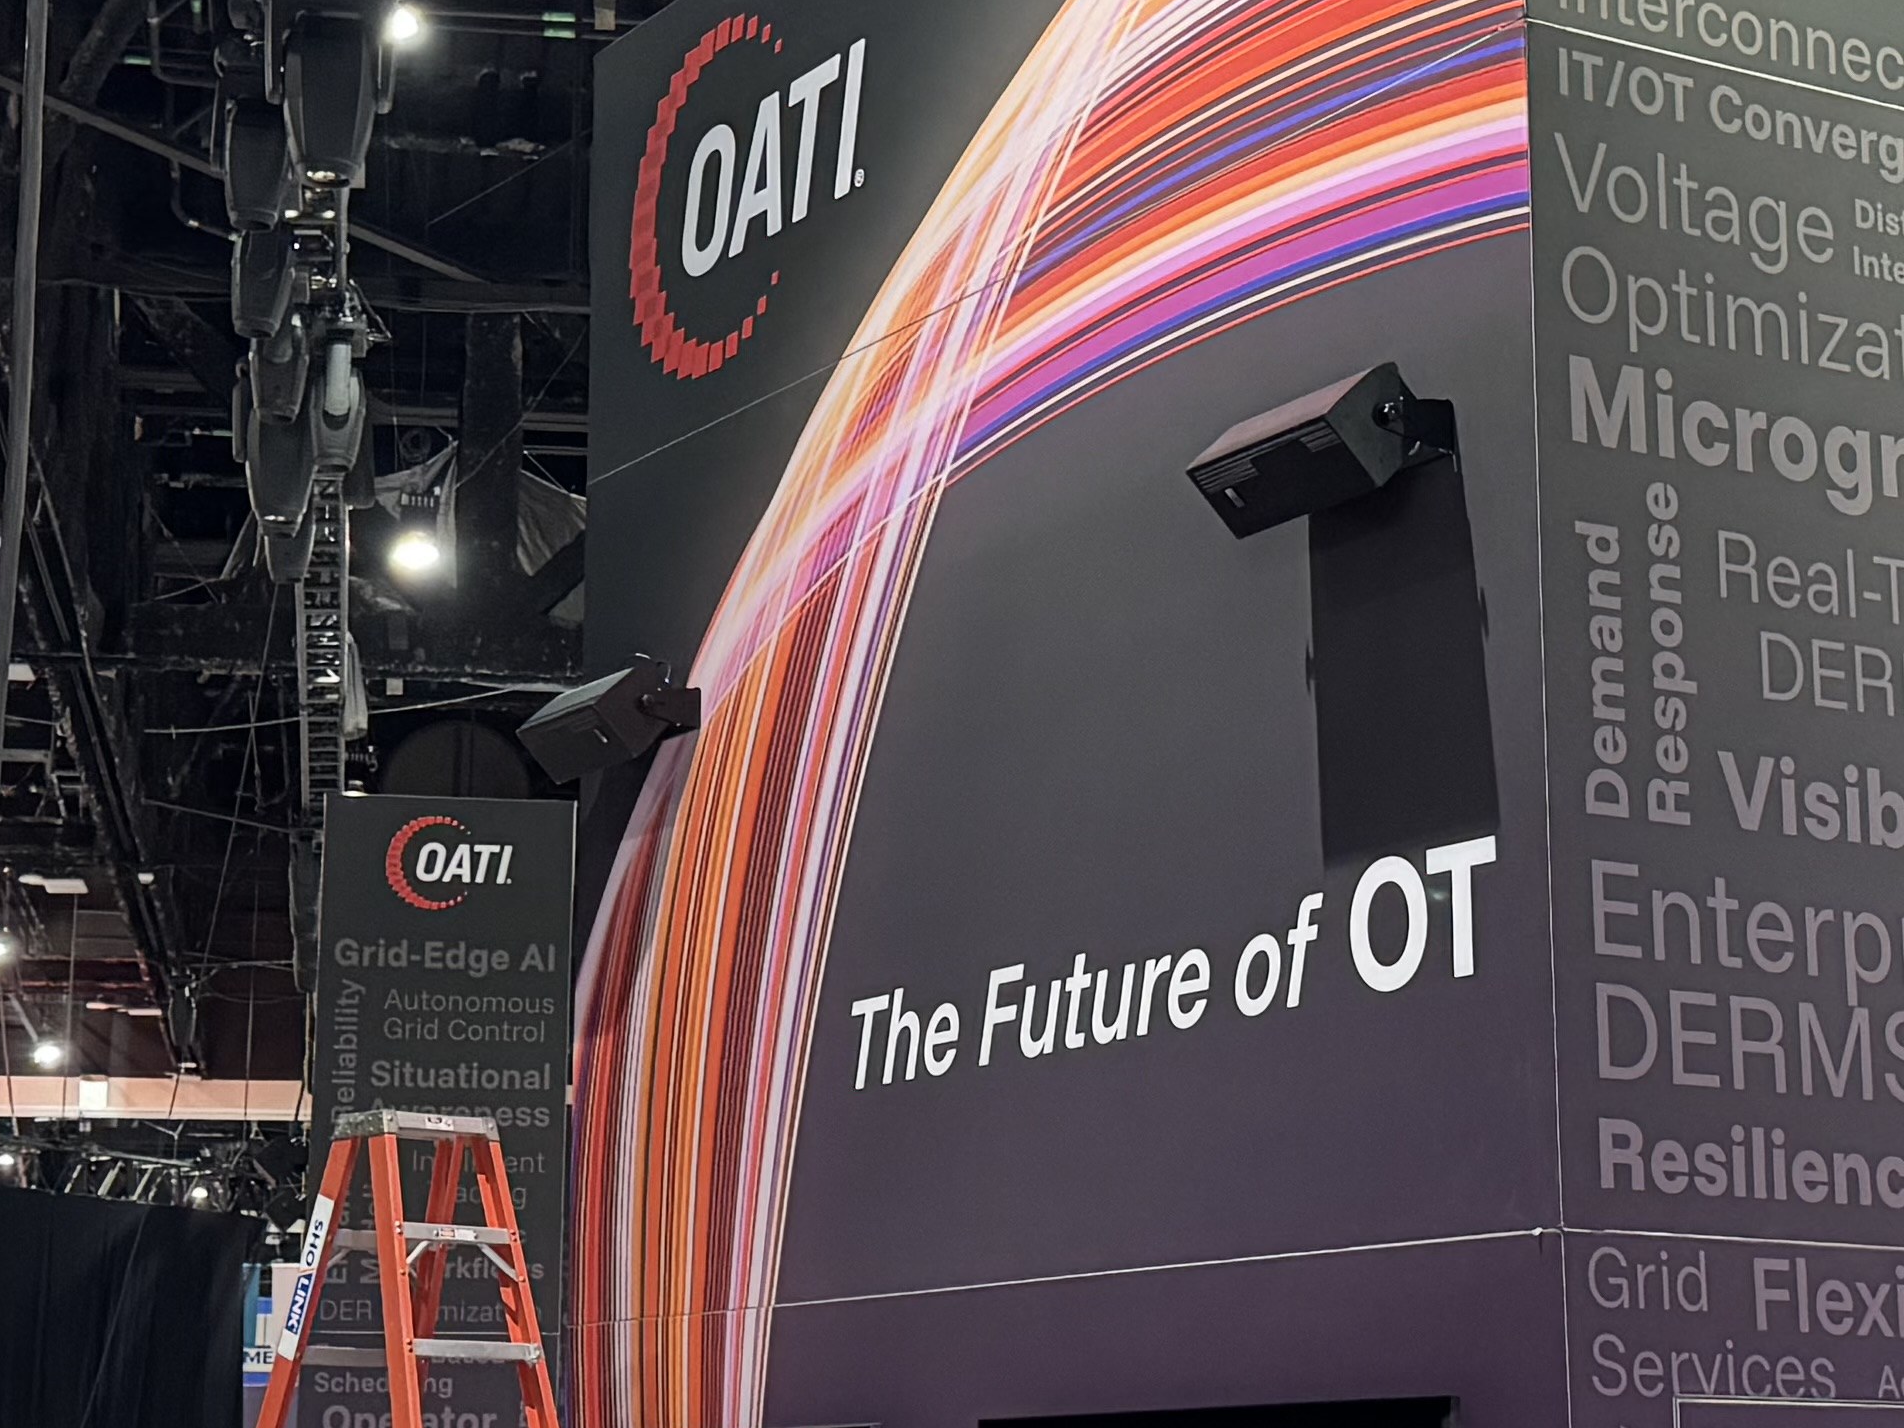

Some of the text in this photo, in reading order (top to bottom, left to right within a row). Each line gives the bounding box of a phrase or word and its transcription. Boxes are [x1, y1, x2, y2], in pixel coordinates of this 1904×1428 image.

[1557, 47, 1694, 123] IT/OT
[1553, 132, 1835, 275] Voltage
[1575, 520, 1630, 819] Demand
[1645, 481, 1698, 827] Response
[334, 938, 556, 978] Grid-Edge AI
[850, 836, 1496, 1092] The Future of OT
[383, 1017, 545, 1043] Grid Control
[384, 988, 555, 1015] Autonomous
[331, 978, 367, 1122] Reliability
[370, 1059, 551, 1091] Situational
[1587, 1246, 1709, 1313] Grid
[314, 1372, 454, 1398] Schedng
[1591, 1333, 1837, 1400] Services
